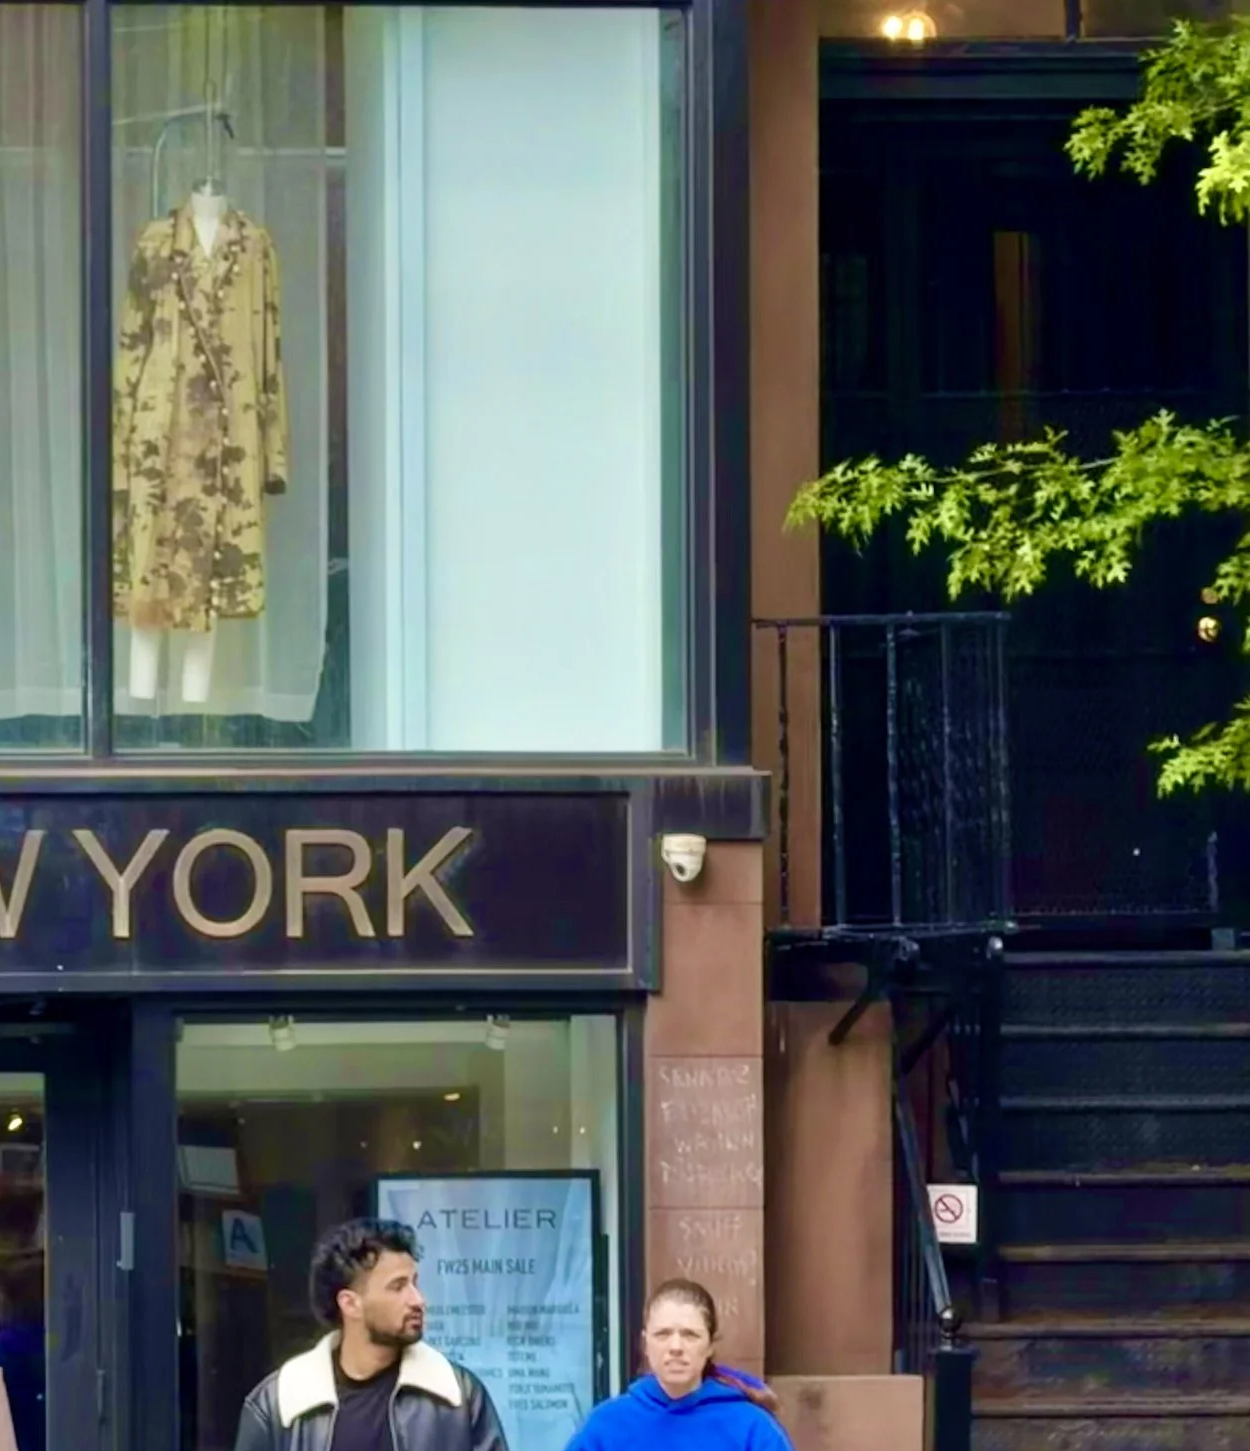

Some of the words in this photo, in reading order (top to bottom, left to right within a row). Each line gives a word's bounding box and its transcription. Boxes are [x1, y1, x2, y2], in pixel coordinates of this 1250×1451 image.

[73, 826, 474, 940] YORK
[417, 1208, 557, 1230] ATELIER
[230, 1217, 259, 1254] A
[472, 1259, 501, 1275] MAIN
[506, 1258, 536, 1275] SALE
